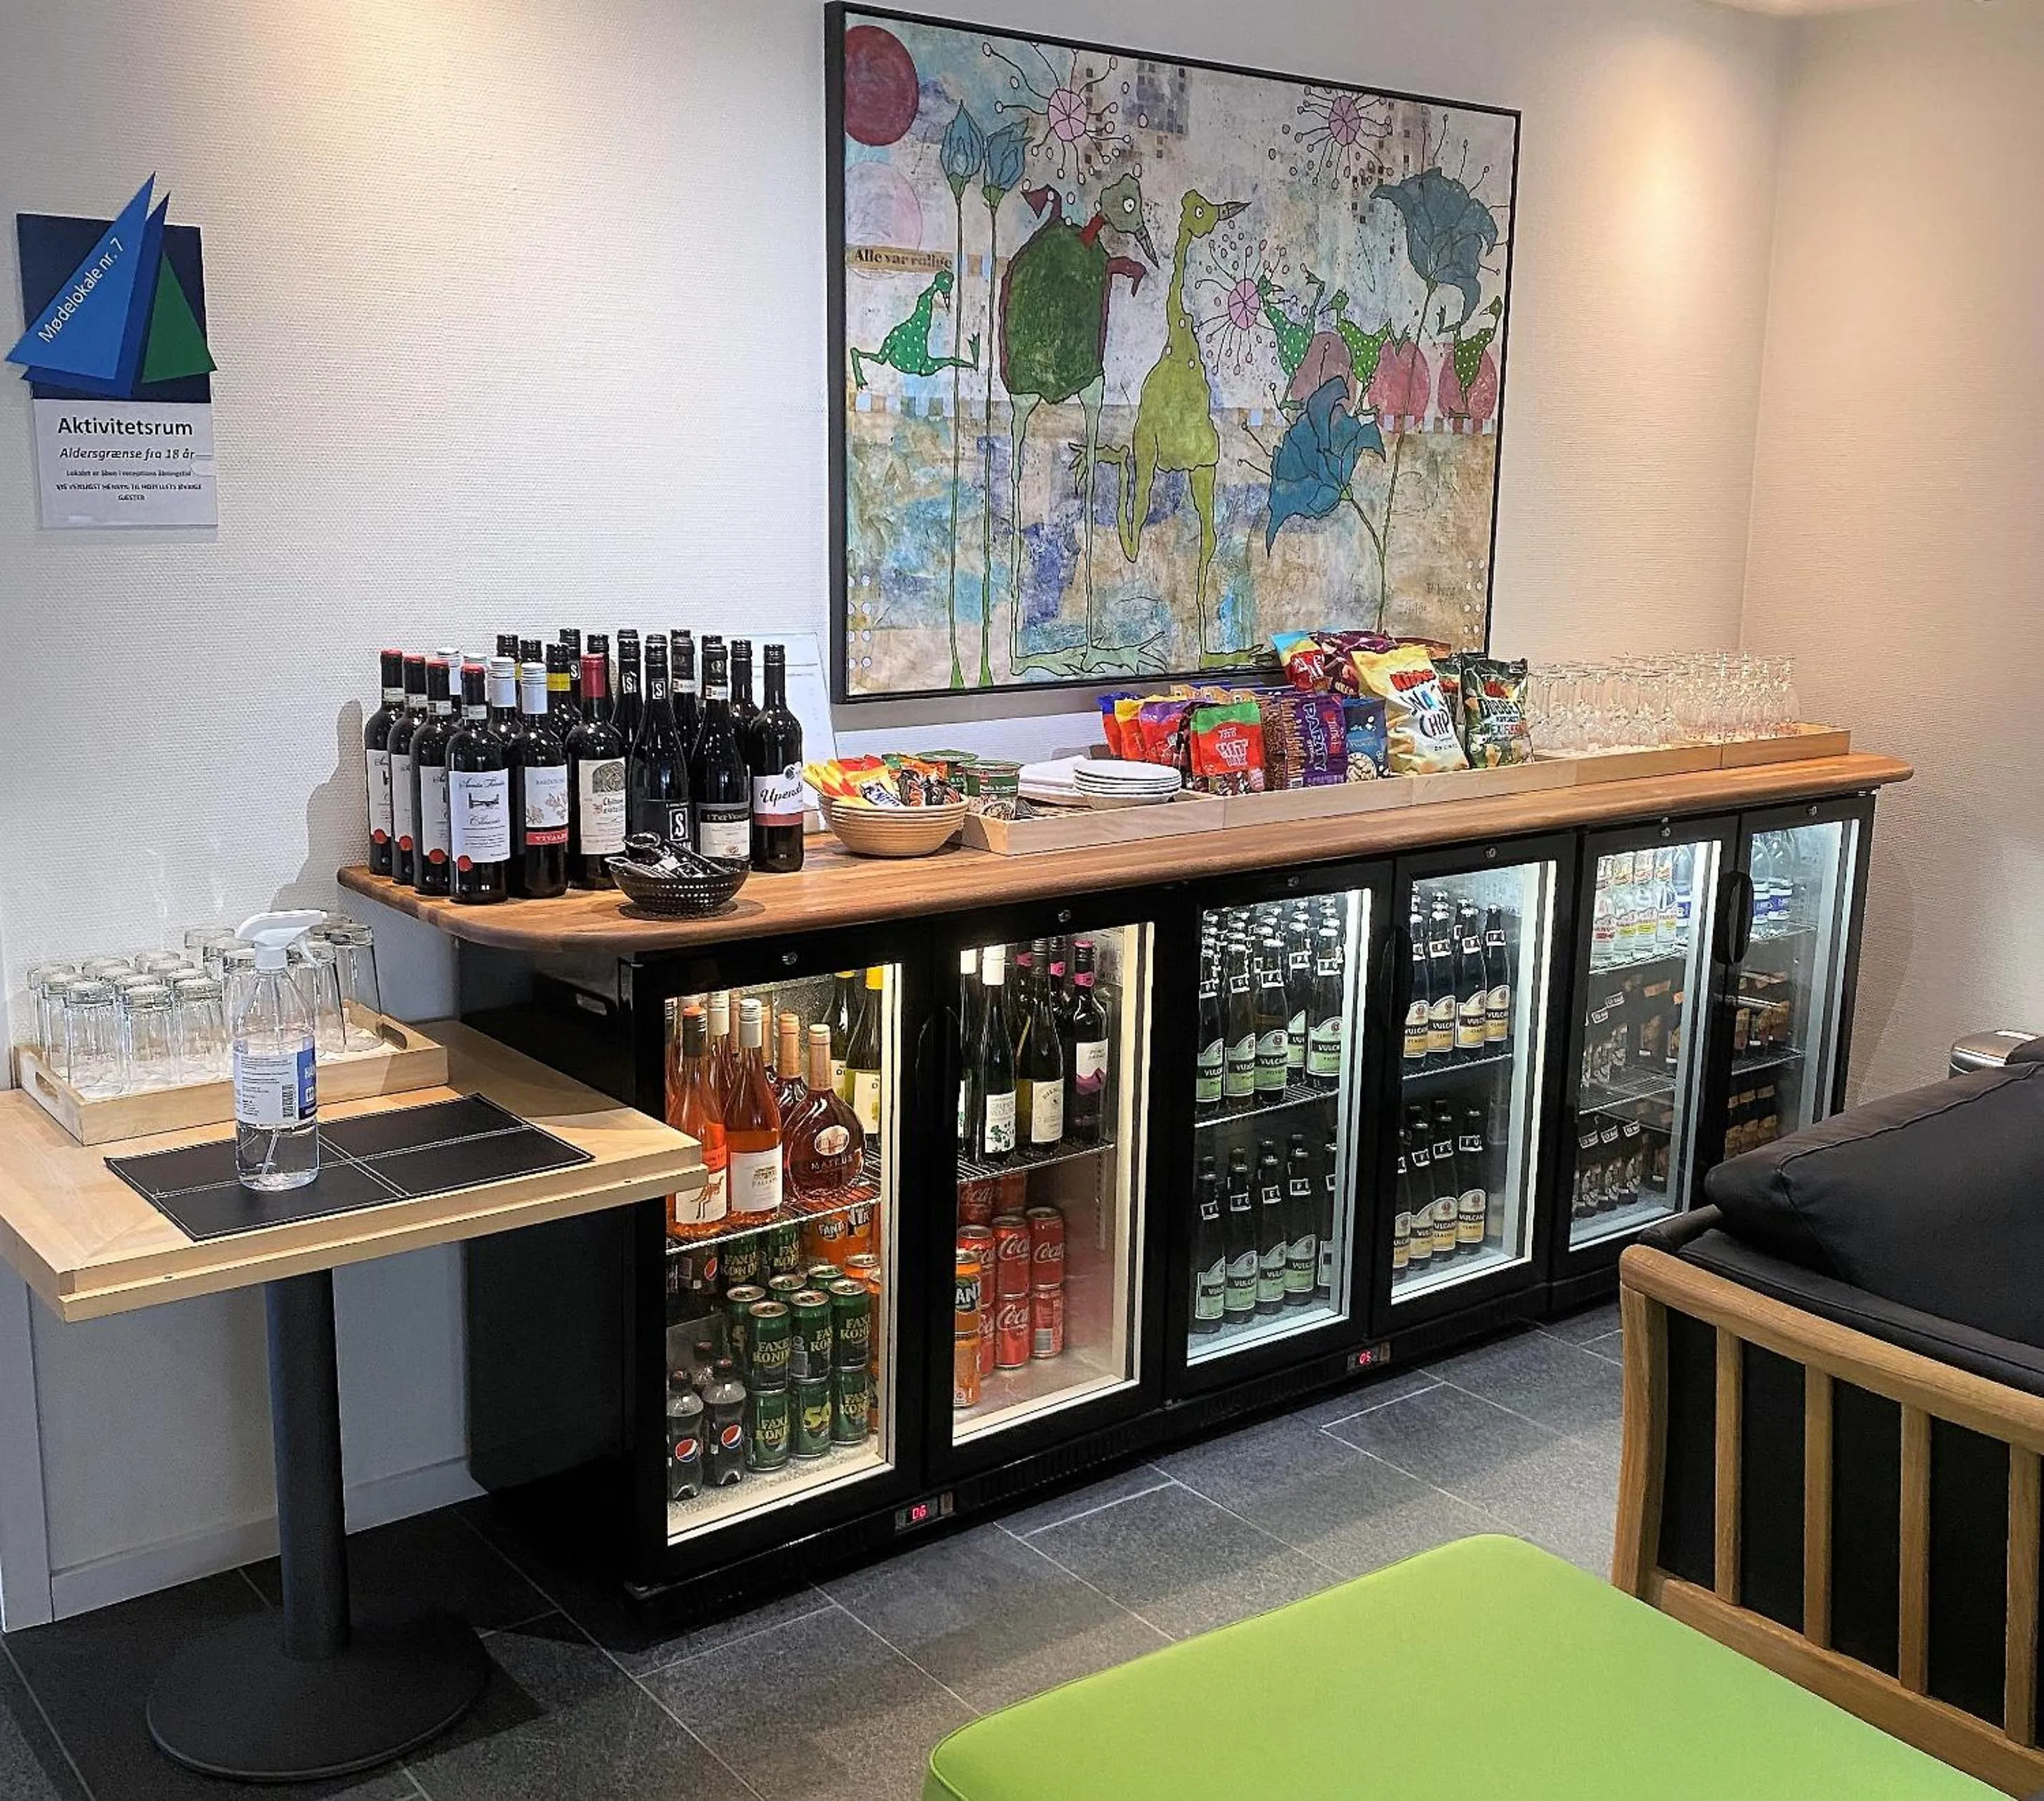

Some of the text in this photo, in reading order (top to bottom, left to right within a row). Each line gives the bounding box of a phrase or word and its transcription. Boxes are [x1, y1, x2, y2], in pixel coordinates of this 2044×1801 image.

[854, 248, 882, 263] Alle
[38, 237, 123, 343] Mødelokale nr. 7
[58, 417, 194, 436] Aktivitetsrum
[60, 447, 196, 461] Aldersgrænse fra 18 år
[760, 781, 803, 807] Upend
